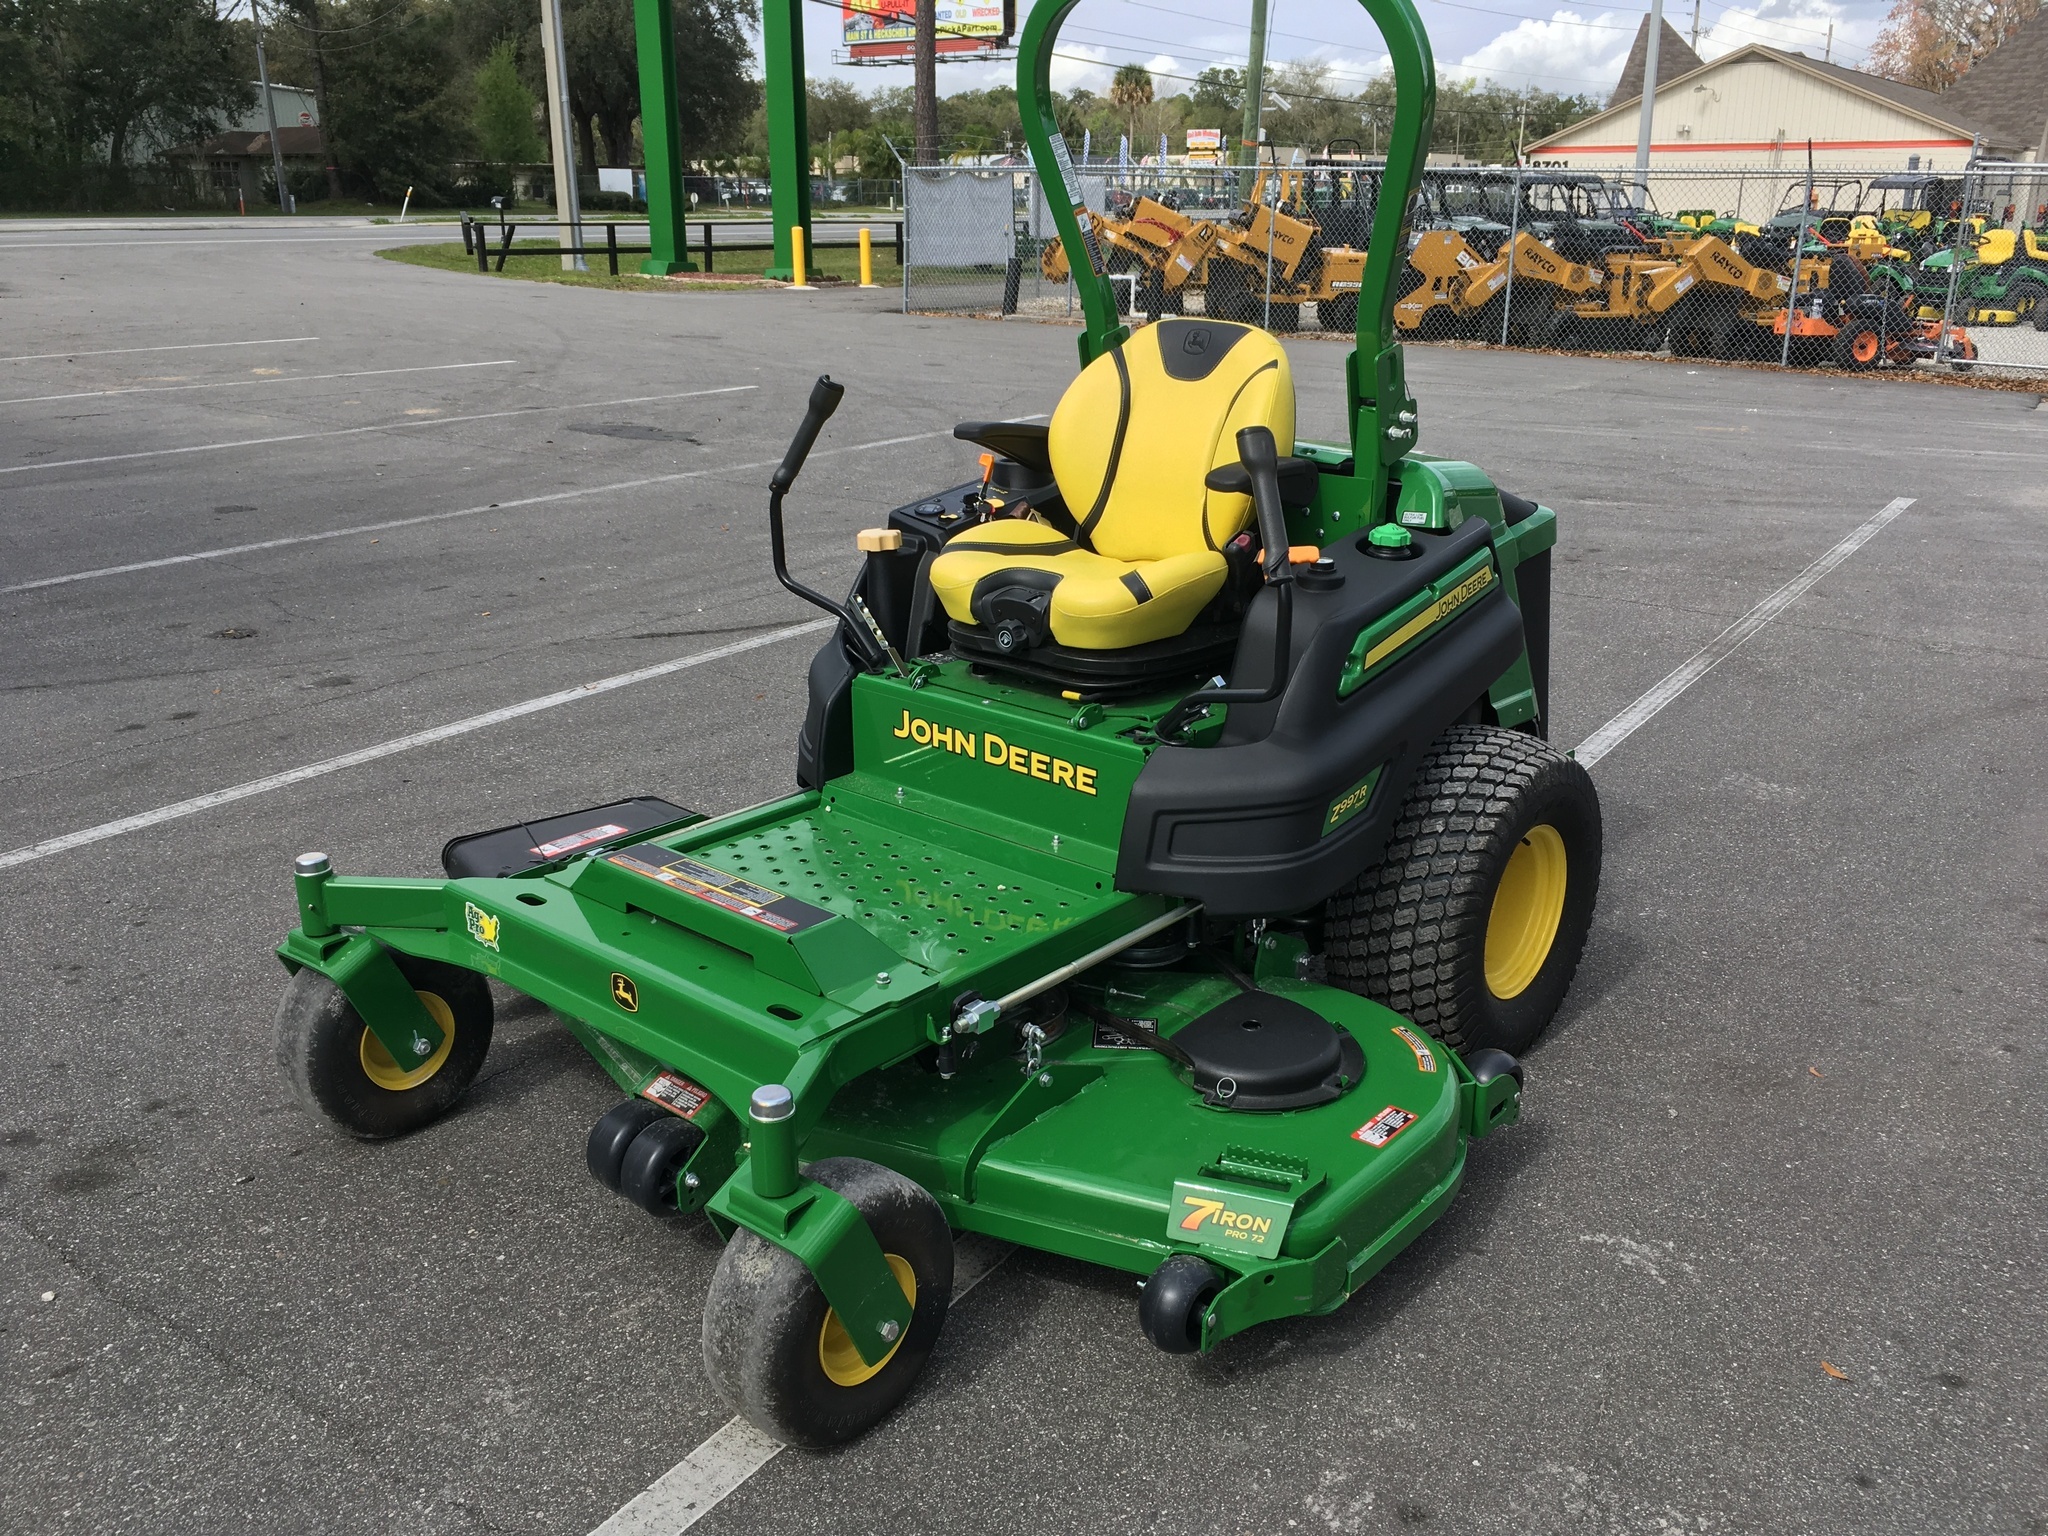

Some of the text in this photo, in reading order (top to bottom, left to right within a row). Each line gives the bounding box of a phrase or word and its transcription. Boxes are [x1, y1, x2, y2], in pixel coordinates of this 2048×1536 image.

[972, 7, 1000, 17] WRECKED
[1523, 248, 1556, 274] RAYCO
[1710, 251, 1743, 279] RAYCO
[1436, 572, 1487, 619] JOHN DEERE
[893, 709, 1098, 797] JOHN DEERE
[1330, 785, 1368, 823] Z997R
[470, 918, 485, 934] Pro
[1224, 1229, 1265, 1244] PRO 72
